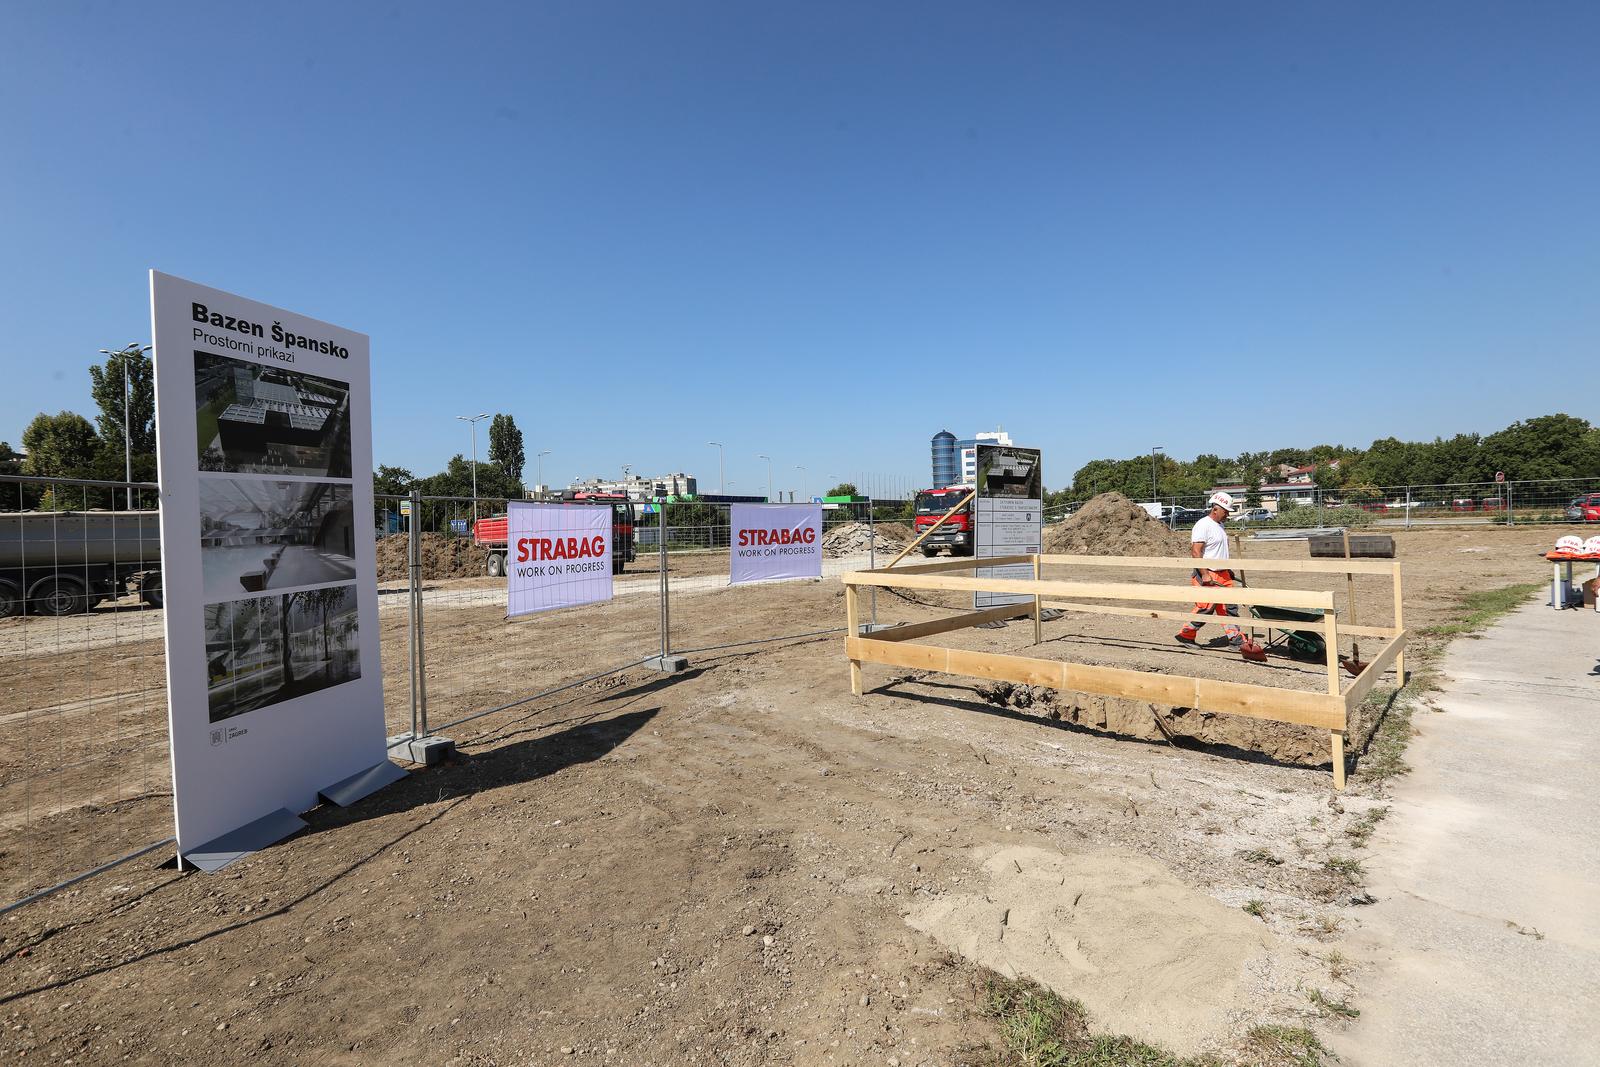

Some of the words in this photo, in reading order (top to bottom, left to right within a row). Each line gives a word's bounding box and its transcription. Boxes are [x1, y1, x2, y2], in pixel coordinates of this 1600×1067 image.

[192, 302, 264, 338] Bazen
[271, 320, 349, 360] Špansko
[193, 327, 254, 354] Prostorni
[257, 344, 295, 364] prikazi
[517, 535, 605, 563] STRABAG
[738, 527, 816, 547] STRABAG
[738, 549, 762, 557] WORK
[764, 548, 777, 556] ON
[779, 547, 815, 555] PROGRESS
[517, 566, 546, 578] WORK
[548, 565, 563, 576] ON
[566, 561, 605, 574] PROGRESS
